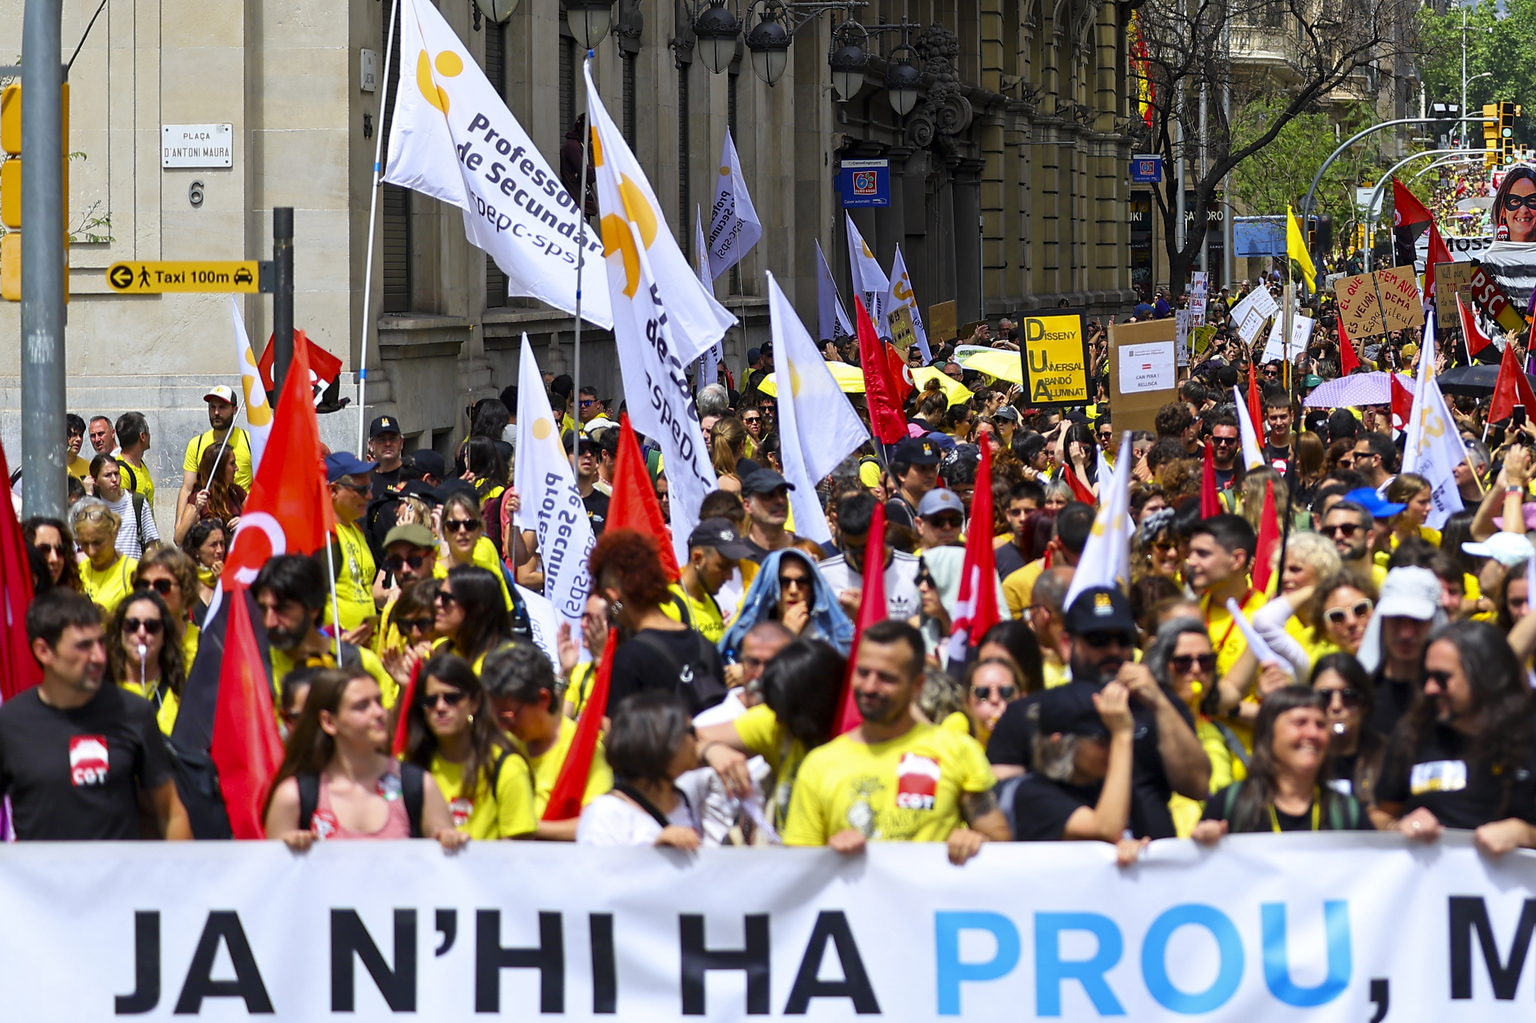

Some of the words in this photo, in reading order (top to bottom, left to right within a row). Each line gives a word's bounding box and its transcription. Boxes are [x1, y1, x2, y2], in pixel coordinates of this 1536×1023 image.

[183, 132, 211, 141] PLAÇA
[164, 147, 201, 158] D'ANTONI
[202, 147, 230, 158] MAURA
[457, 141, 483, 171] de
[467, 112, 585, 216] Professor
[188, 180, 204, 205] 6
[155, 271, 185, 284] Taxi
[191, 271, 229, 284] 100m
[1340, 296, 1351, 311] EL
[1347, 276, 1364, 296] QUE
[1378, 270, 1398, 285] FEM
[1396, 279, 1418, 300] AVUI
[1471, 272, 1504, 316] PSC
[1348, 321, 1358, 334] ES
[1384, 291, 1411, 311] DEMÀ
[72, 768, 107, 785] CGT
[897, 792, 935, 810] CGT
[114, 910, 276, 1016] JA
[330, 907, 618, 1015] N'HI
[679, 909, 882, 1016] HA
[934, 899, 1391, 1023] PROU,
